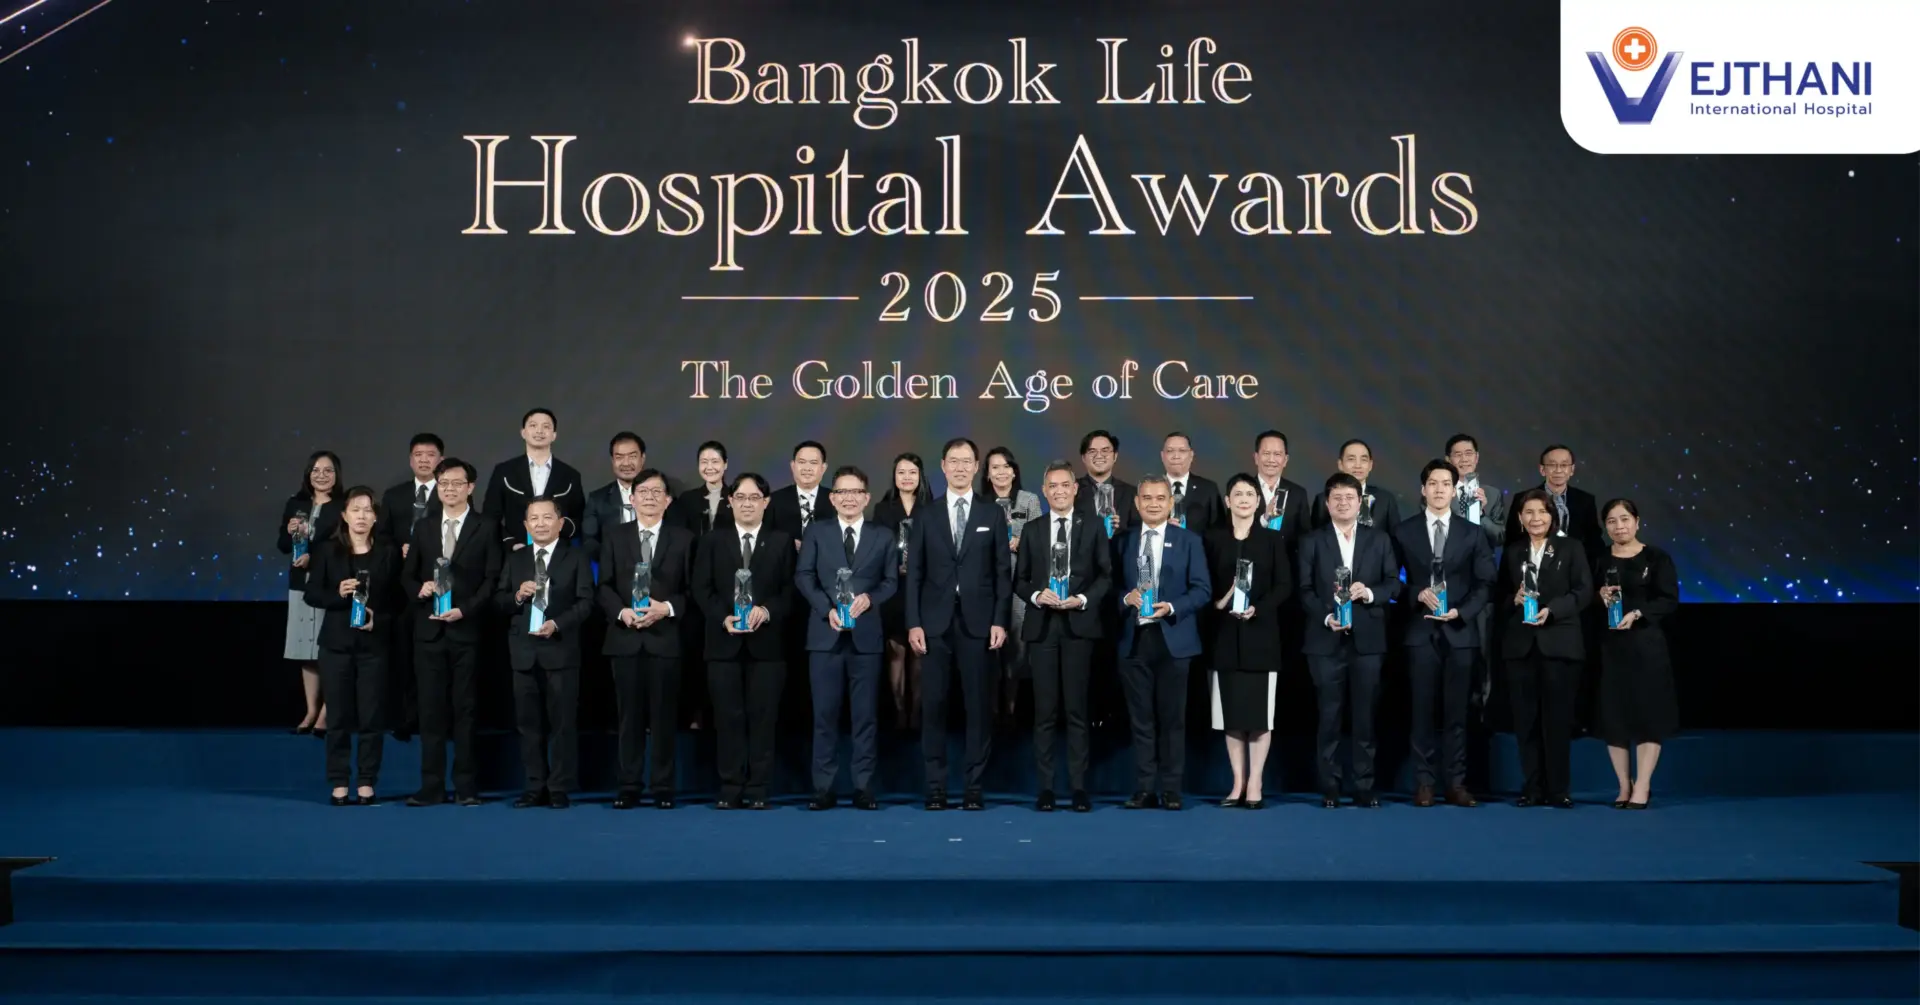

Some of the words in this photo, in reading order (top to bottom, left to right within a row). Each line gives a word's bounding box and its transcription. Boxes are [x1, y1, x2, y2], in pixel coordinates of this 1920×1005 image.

[690, 36, 1062, 129] Bangkok
[1097, 37, 1253, 104] Life
[461, 134, 970, 270] Hospital
[1026, 134, 1479, 237] Awards
[878, 271, 1062, 323] 2025
[681, 360, 773, 400] The
[792, 360, 960, 400] Golden
[978, 360, 1074, 414] Age
[1091, 358, 1139, 400] of
[1152, 360, 1259, 400] Care
